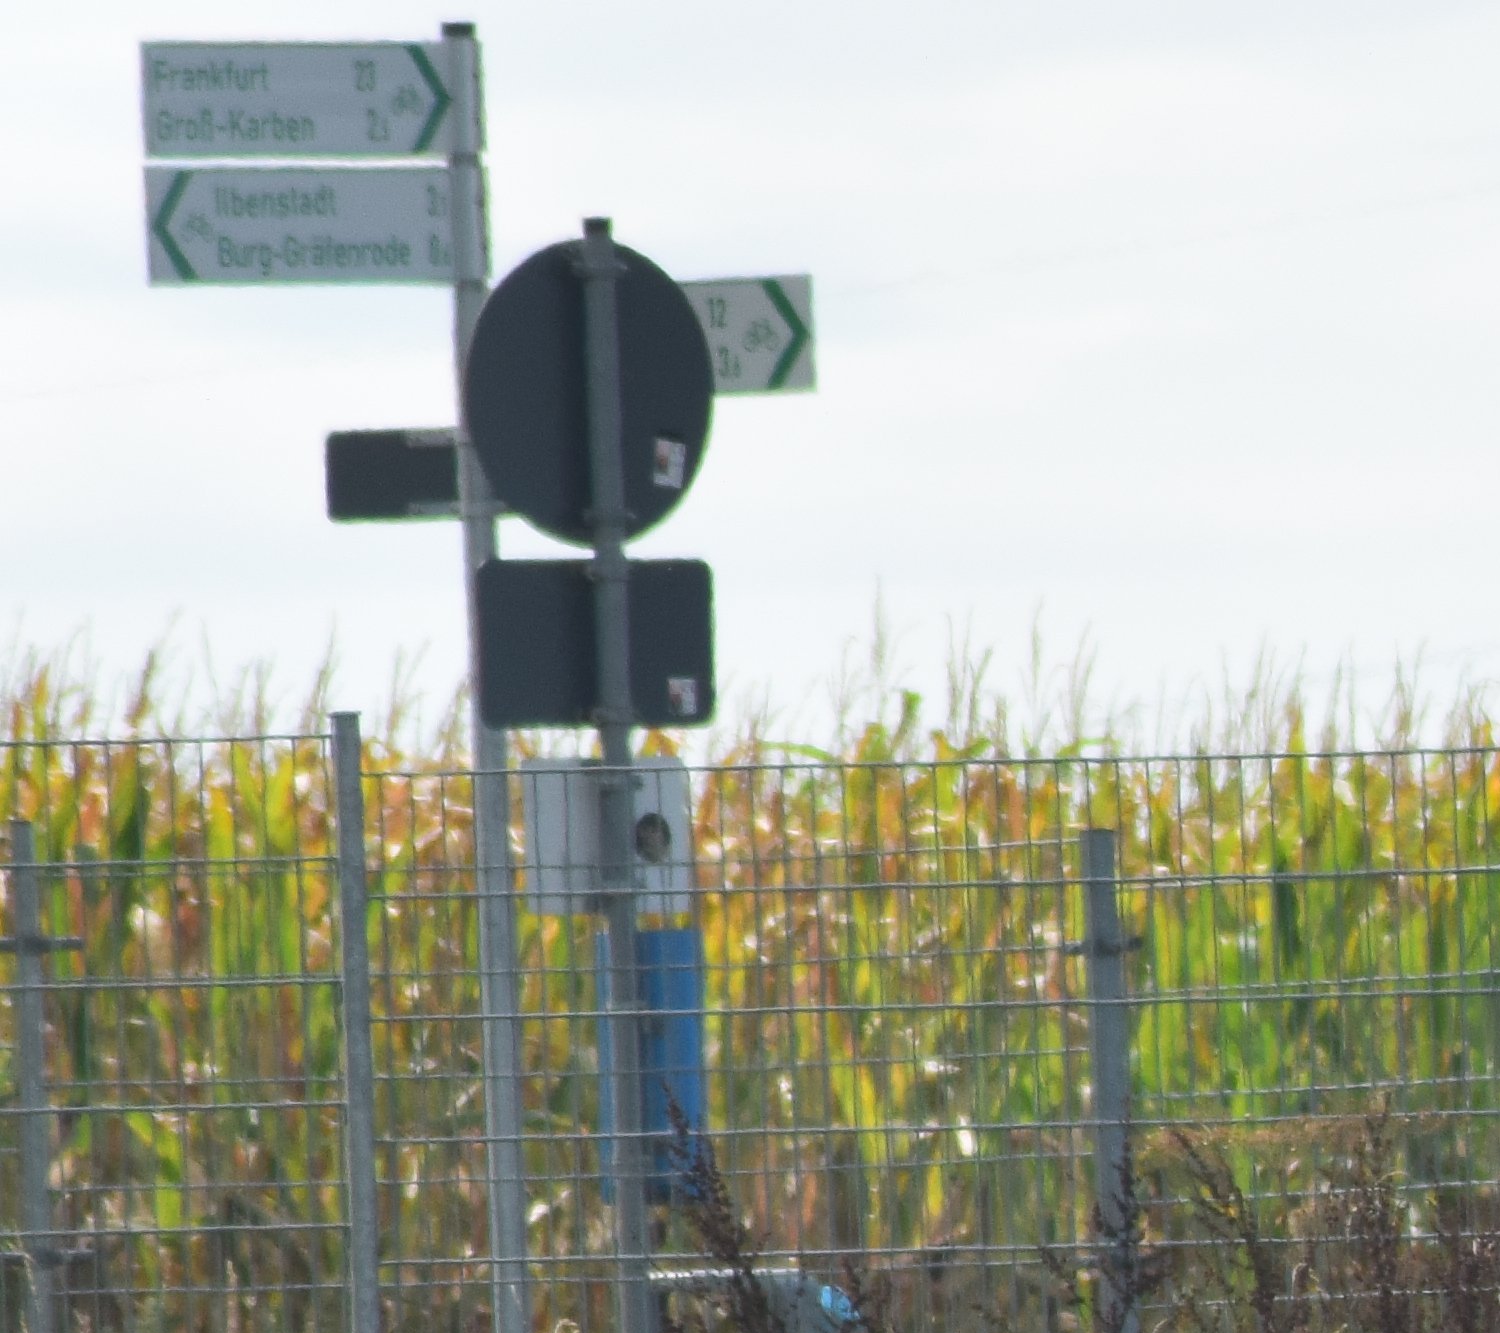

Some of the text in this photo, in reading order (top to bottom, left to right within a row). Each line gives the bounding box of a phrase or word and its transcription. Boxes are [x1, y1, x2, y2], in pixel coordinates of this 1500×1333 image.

[153, 59, 269, 92] Frankfurt
[156, 107, 317, 144] Groß-Karben
[214, 184, 337, 219] Ilbenstadt
[217, 234, 412, 277] Burg-Gräfenrode
